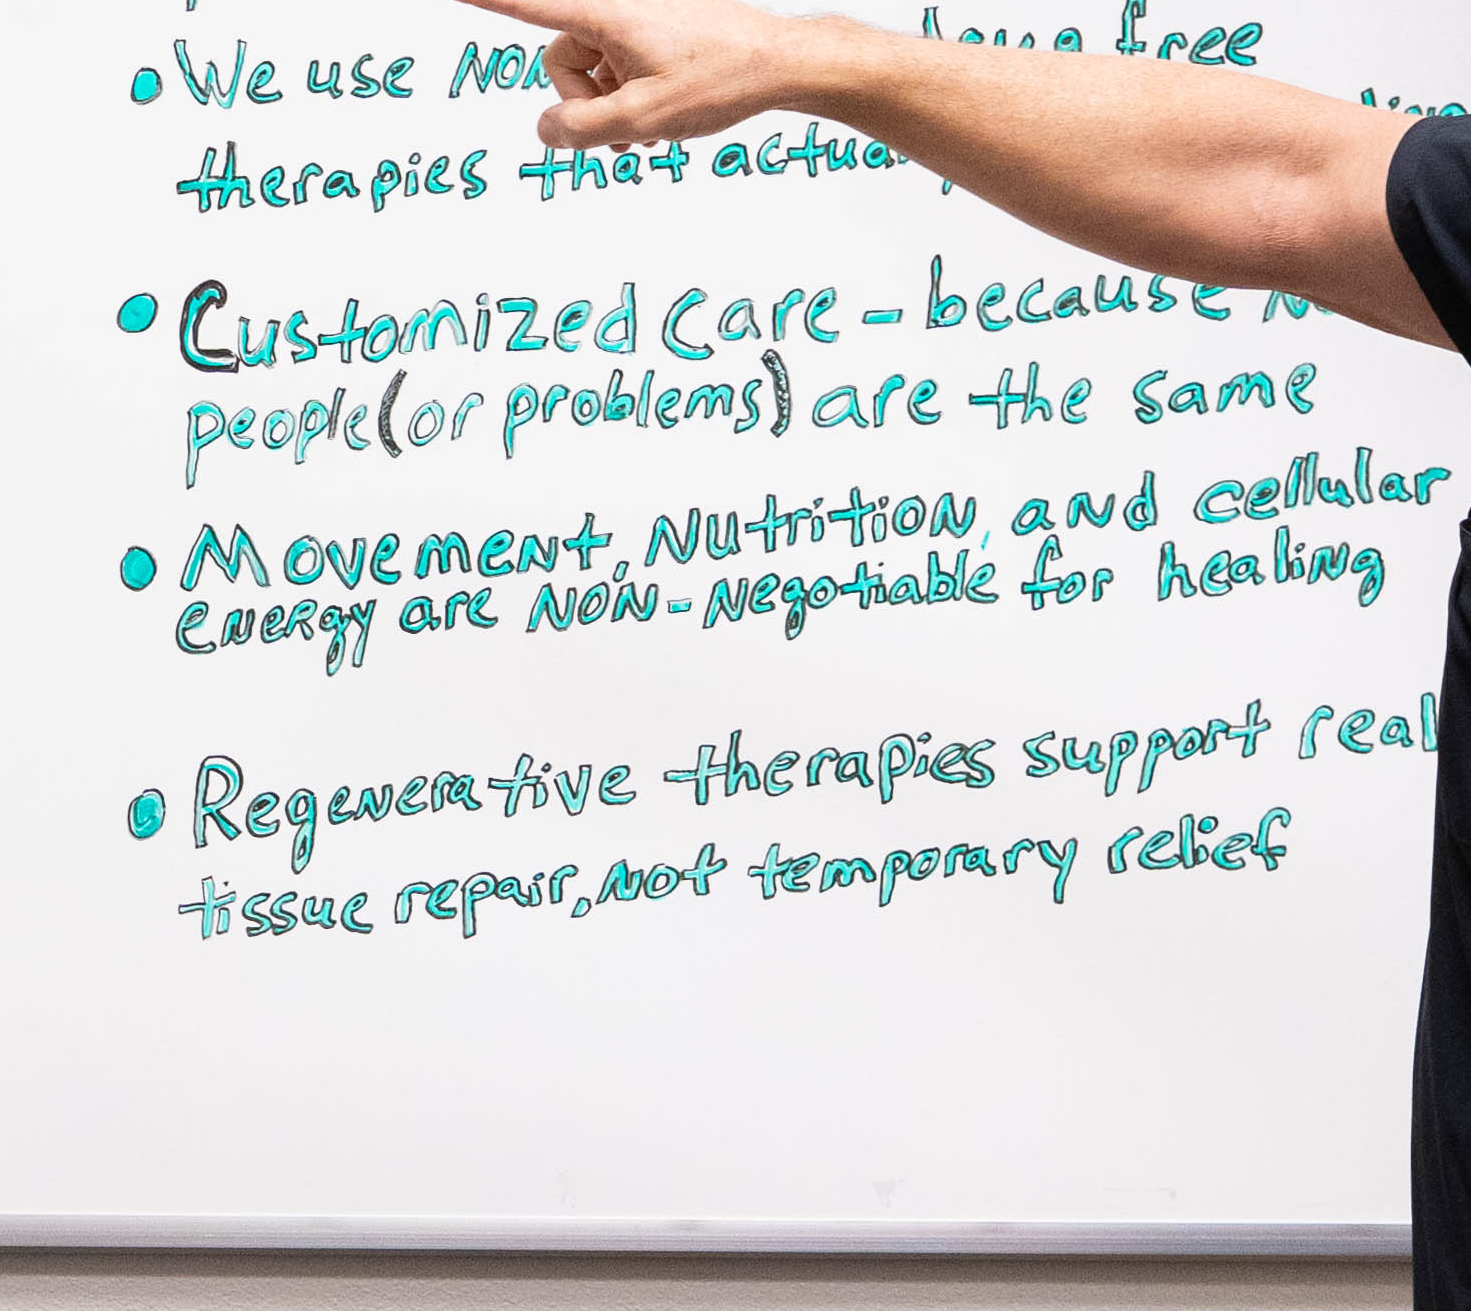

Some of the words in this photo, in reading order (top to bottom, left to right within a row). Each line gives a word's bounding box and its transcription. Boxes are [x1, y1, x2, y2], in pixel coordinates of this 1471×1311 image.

[174, 39, 283, 109] We
[307, 54, 414, 99] use
[177, 141, 487, 213] therapies
[519, 146, 690, 201] that
[180, 280, 636, 373] Customized
[927, 253, 1231, 332] because
[812, 374, 941, 428] are
[969, 362, 1091, 429] the
[1133, 364, 1316, 424] same
[1018, 473, 1159, 533] and
[1194, 448, 1454, 519] cellular
[398, 589, 499, 635] are
[1021, 537, 1113, 610] for
[194, 753, 636, 874] Regenerative
[664, 730, 996, 805] therapies
[1023, 699, 1271, 790] support
[1299, 692, 1440, 759] real
[180, 877, 374, 939] tissue
[748, 838, 1077, 907] temporary
[1108, 807, 1291, 874] relief
